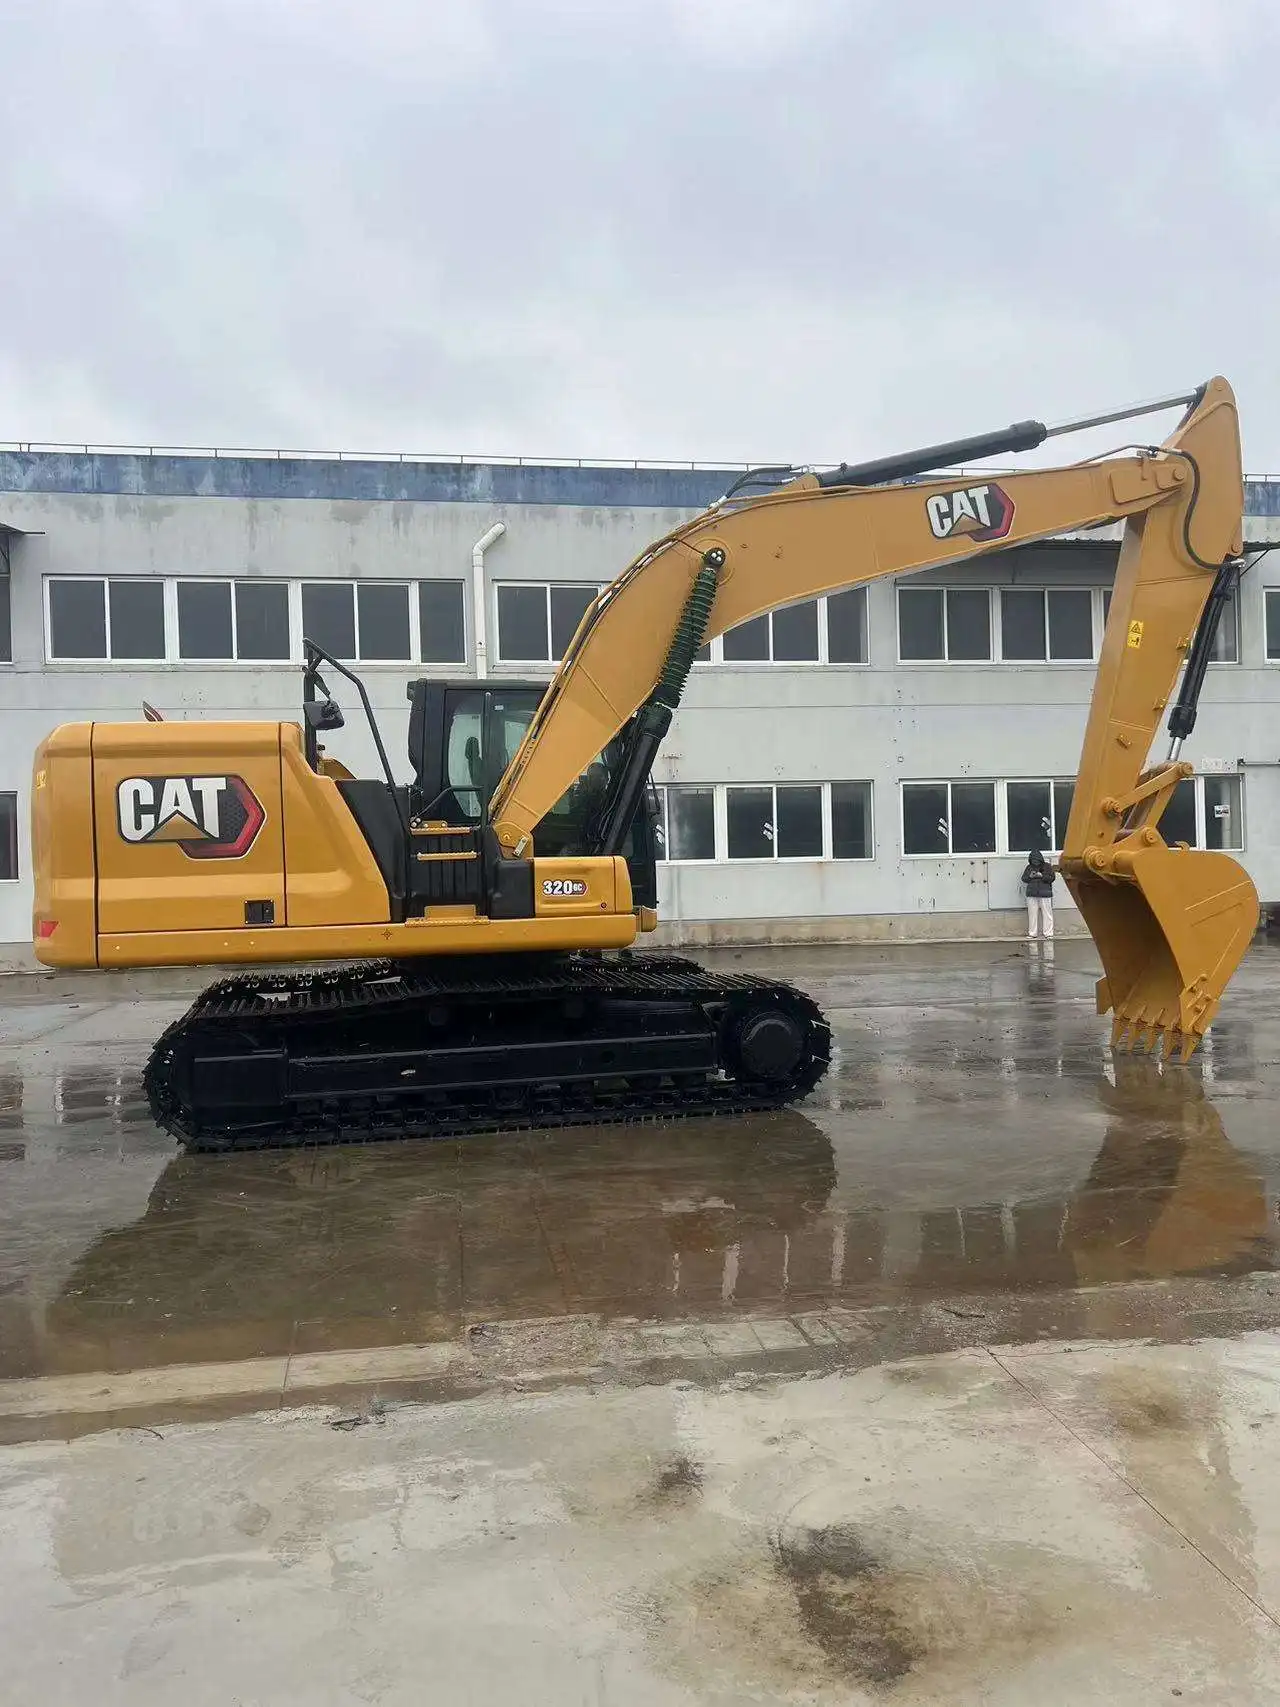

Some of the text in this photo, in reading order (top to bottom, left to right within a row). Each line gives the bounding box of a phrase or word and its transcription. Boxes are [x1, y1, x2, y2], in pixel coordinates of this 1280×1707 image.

[926, 485, 991, 538] CAT
[118, 777, 227, 841] CAT
[543, 880, 583, 895] 320 GC
